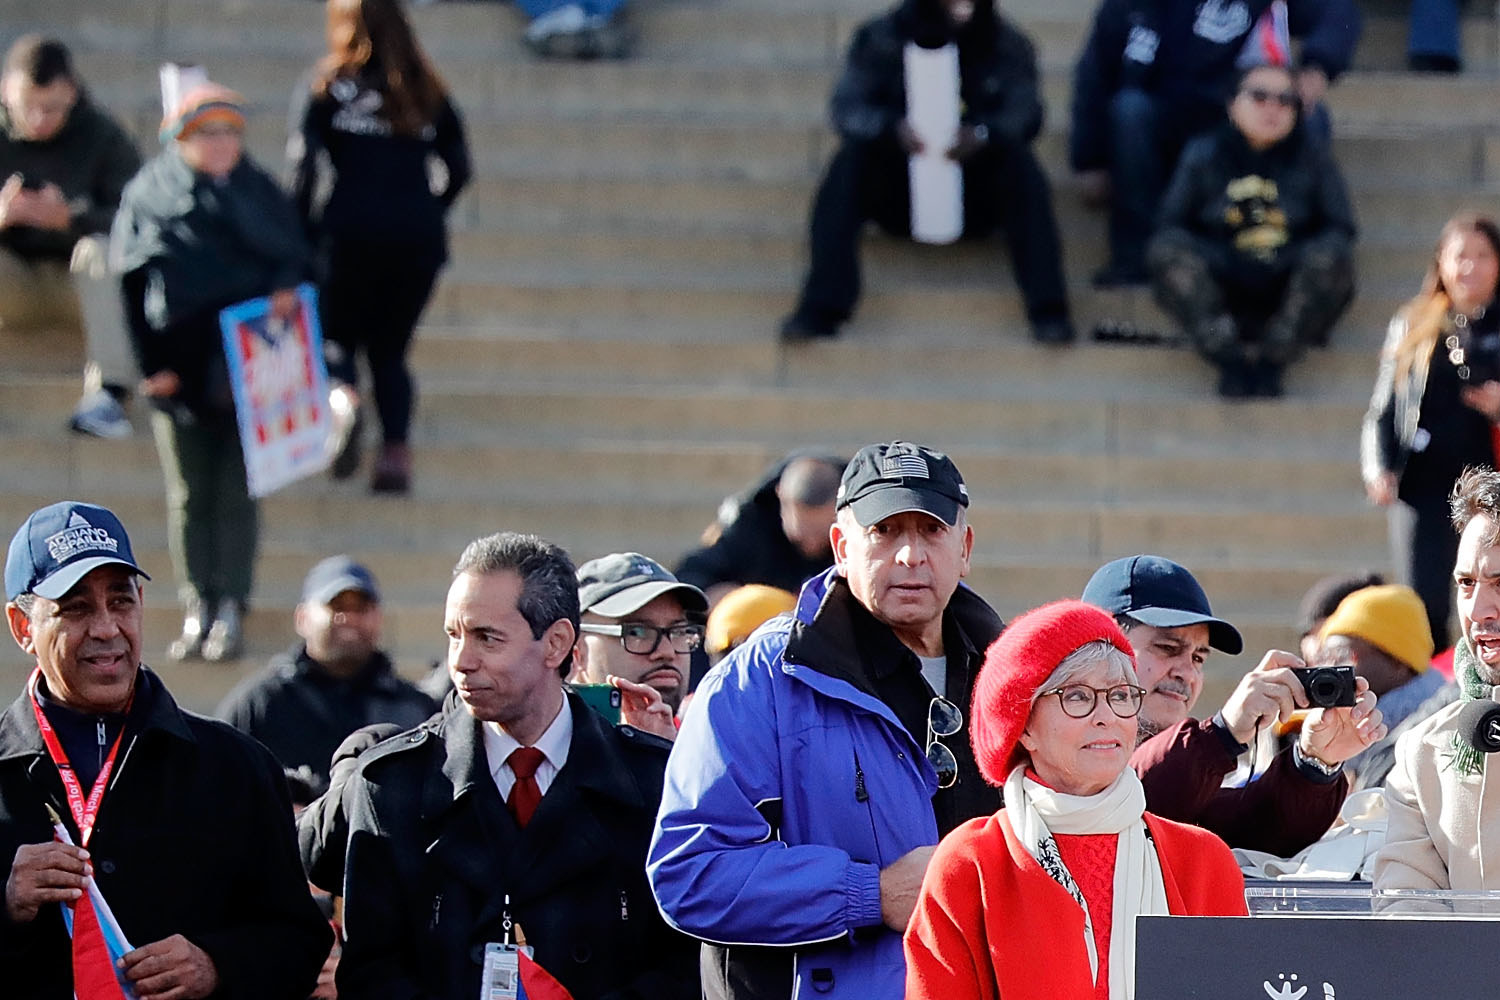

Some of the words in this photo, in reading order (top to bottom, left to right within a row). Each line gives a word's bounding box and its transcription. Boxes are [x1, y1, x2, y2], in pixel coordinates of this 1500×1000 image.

[49, 528, 108, 551] ADRIANO
[61, 769, 75, 784] PR
[86, 783, 103, 812] March
